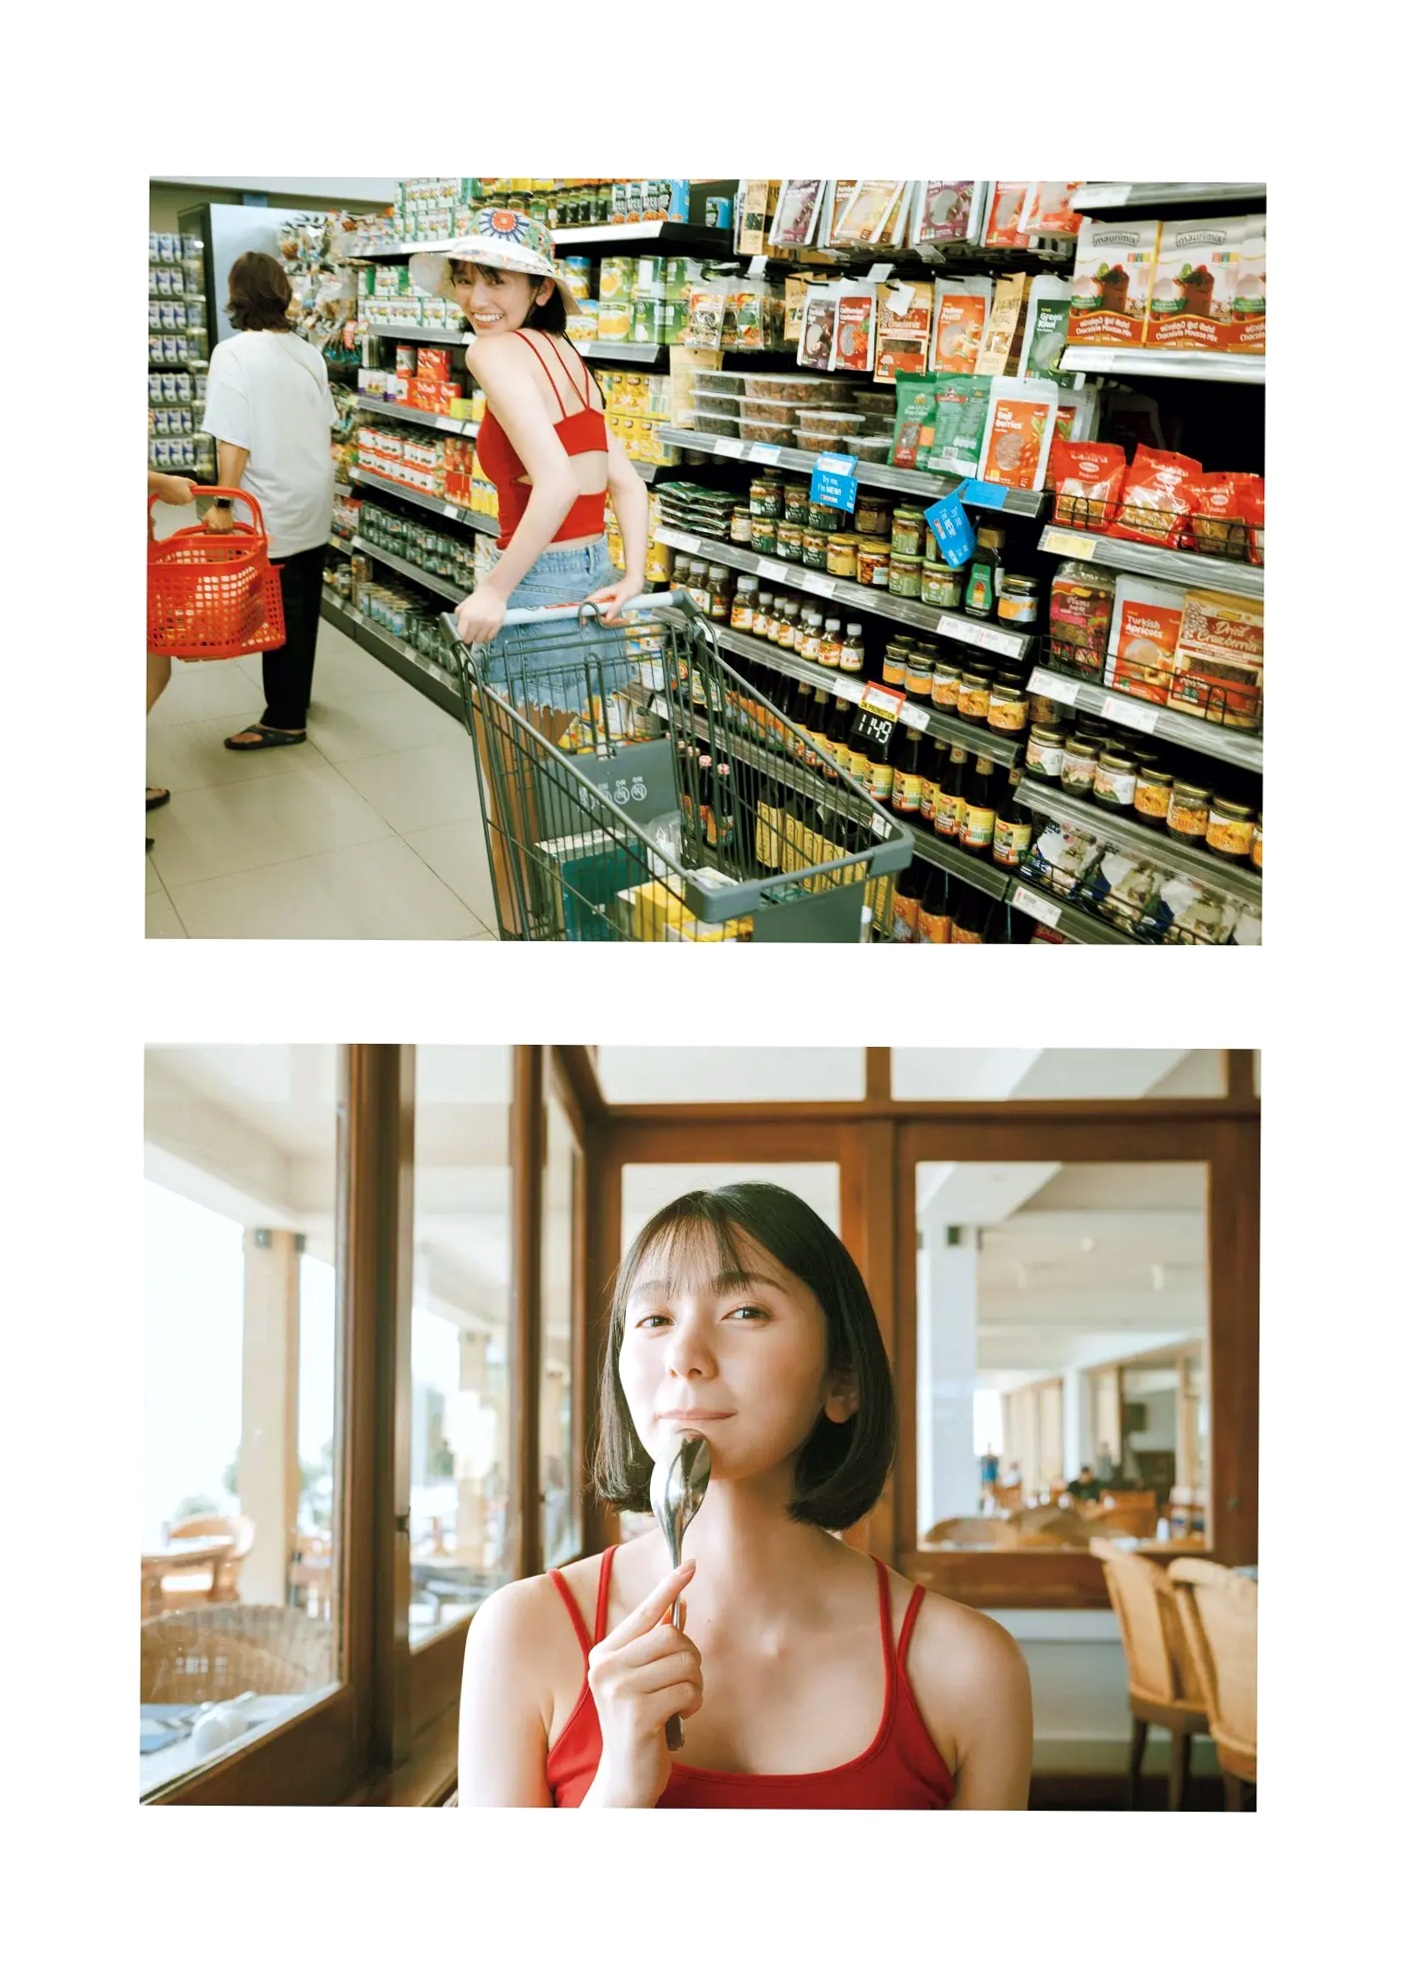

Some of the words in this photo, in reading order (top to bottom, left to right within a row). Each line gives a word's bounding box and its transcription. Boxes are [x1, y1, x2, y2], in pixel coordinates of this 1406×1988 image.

[1095, 233, 1138, 246] maurimix
[1178, 231, 1222, 246] maurimix
[1040, 312, 1063, 322] Green
[1075, 325, 1102, 335] Chocolate
[1102, 324, 1123, 335] Mousse
[1123, 329, 1133, 337] Mix
[1155, 330, 1184, 341] Chocolate
[1184, 328, 1207, 339] Mousse
[1206, 332, 1218, 342] Mix
[1126, 614, 1161, 630] Turkish
[1213, 620, 1250, 637] Dried
[1124, 623, 1163, 639] Apricots
[1197, 629, 1257, 653] Cranberries
[858, 714, 892, 744] 1149
